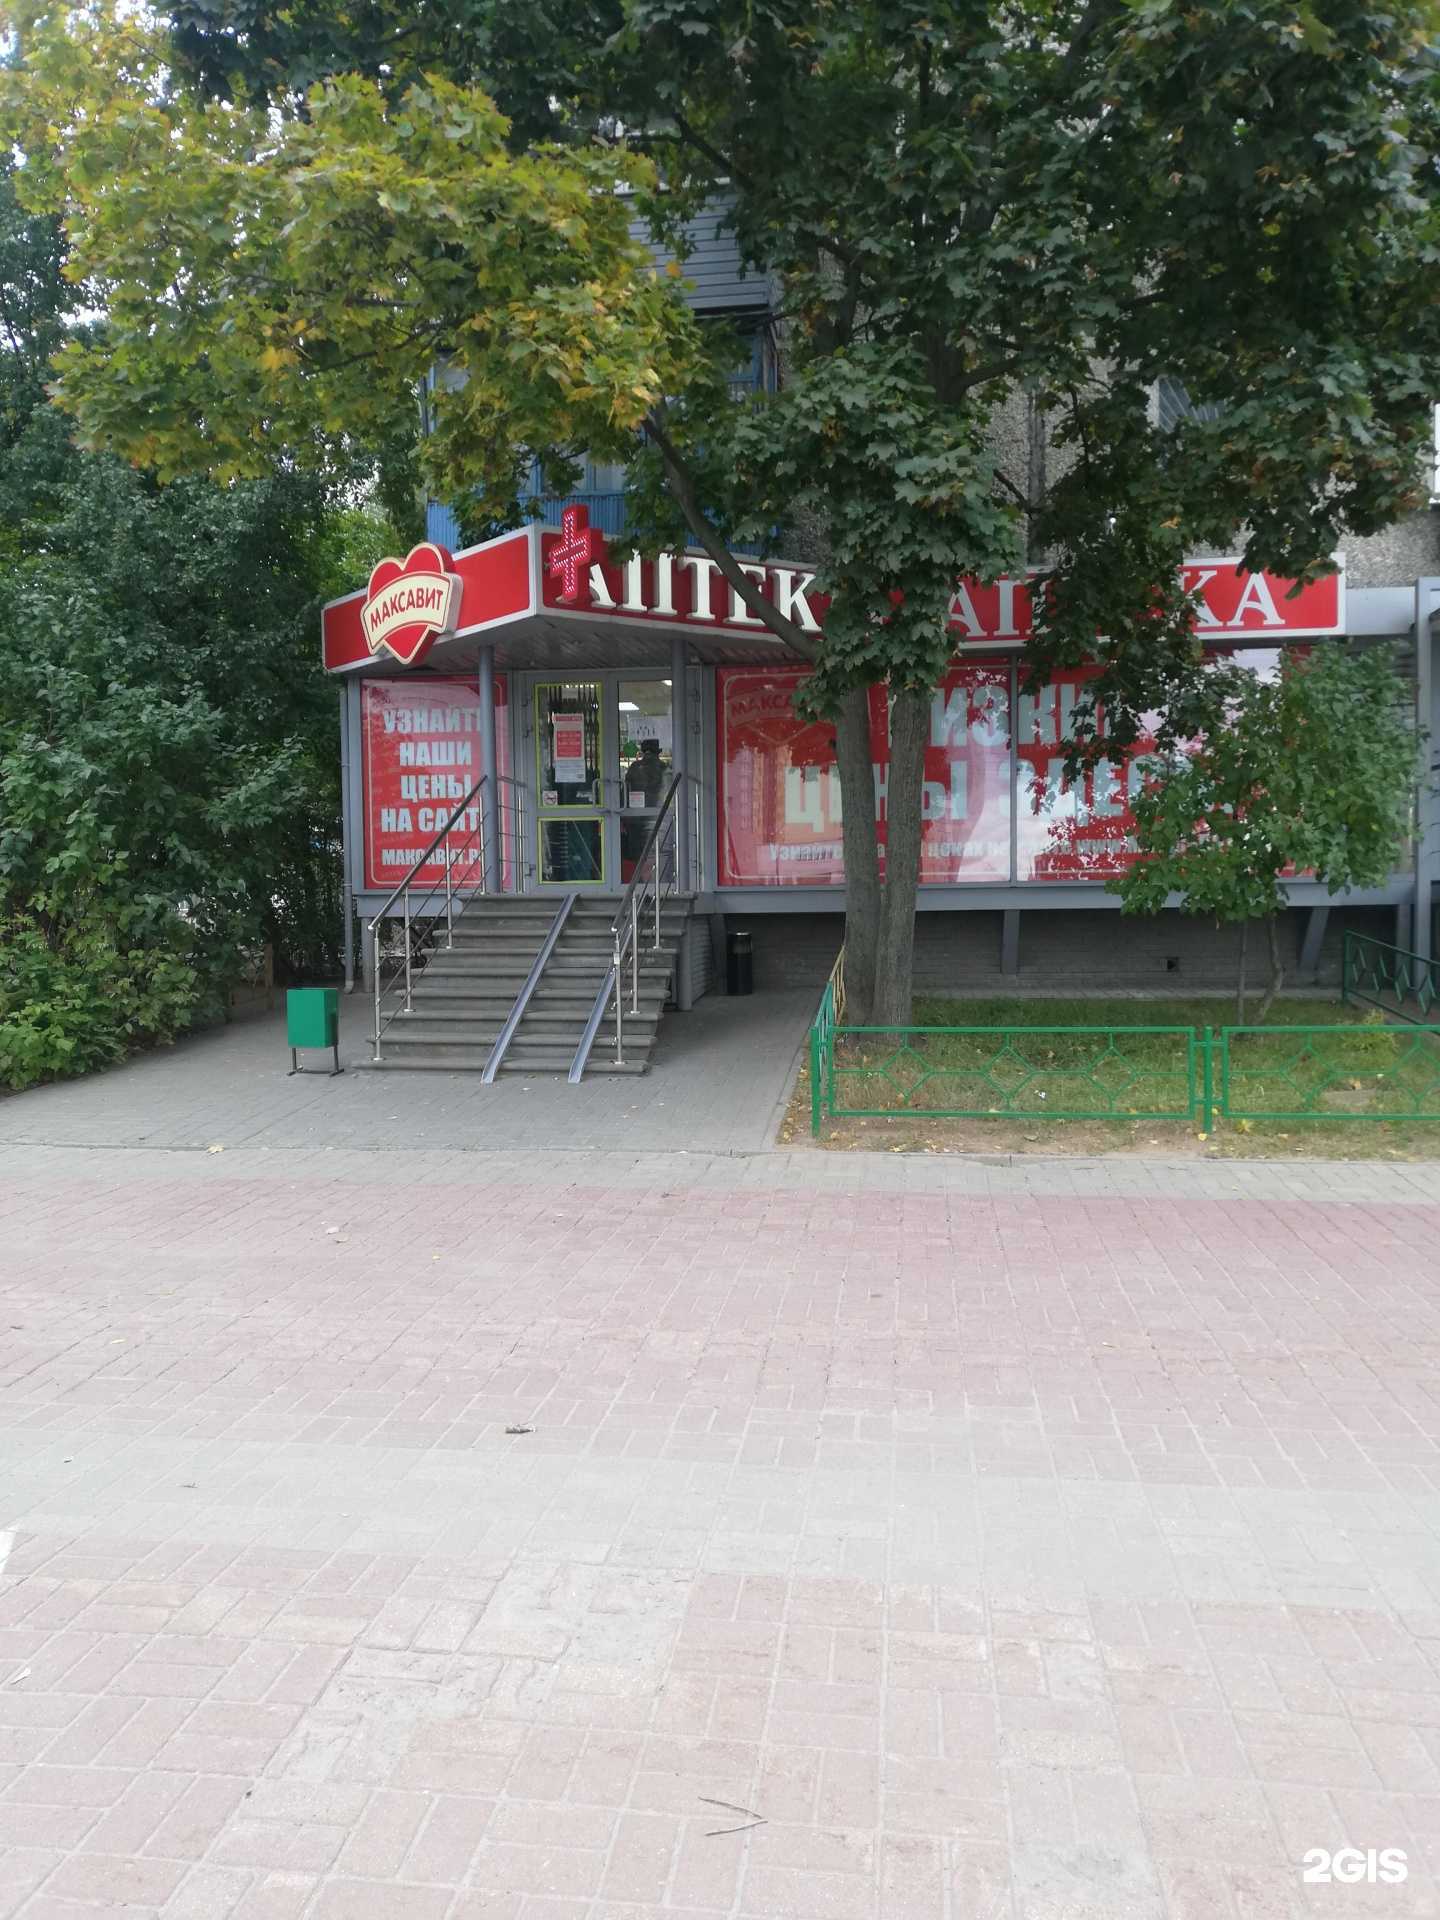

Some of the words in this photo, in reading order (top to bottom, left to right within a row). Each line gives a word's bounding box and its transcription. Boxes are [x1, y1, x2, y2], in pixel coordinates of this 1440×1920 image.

[554, 545, 823, 633] АПТЕК
[369, 586, 444, 632] МАКСАВИТ
[384, 706, 481, 733] УЗНАЙТ
[400, 741, 472, 767] НАШИ
[401, 774, 472, 803] ЦЕНЫ
[381, 807, 414, 832] НА
[382, 849, 480, 865] МАКСАВИТ.Р
